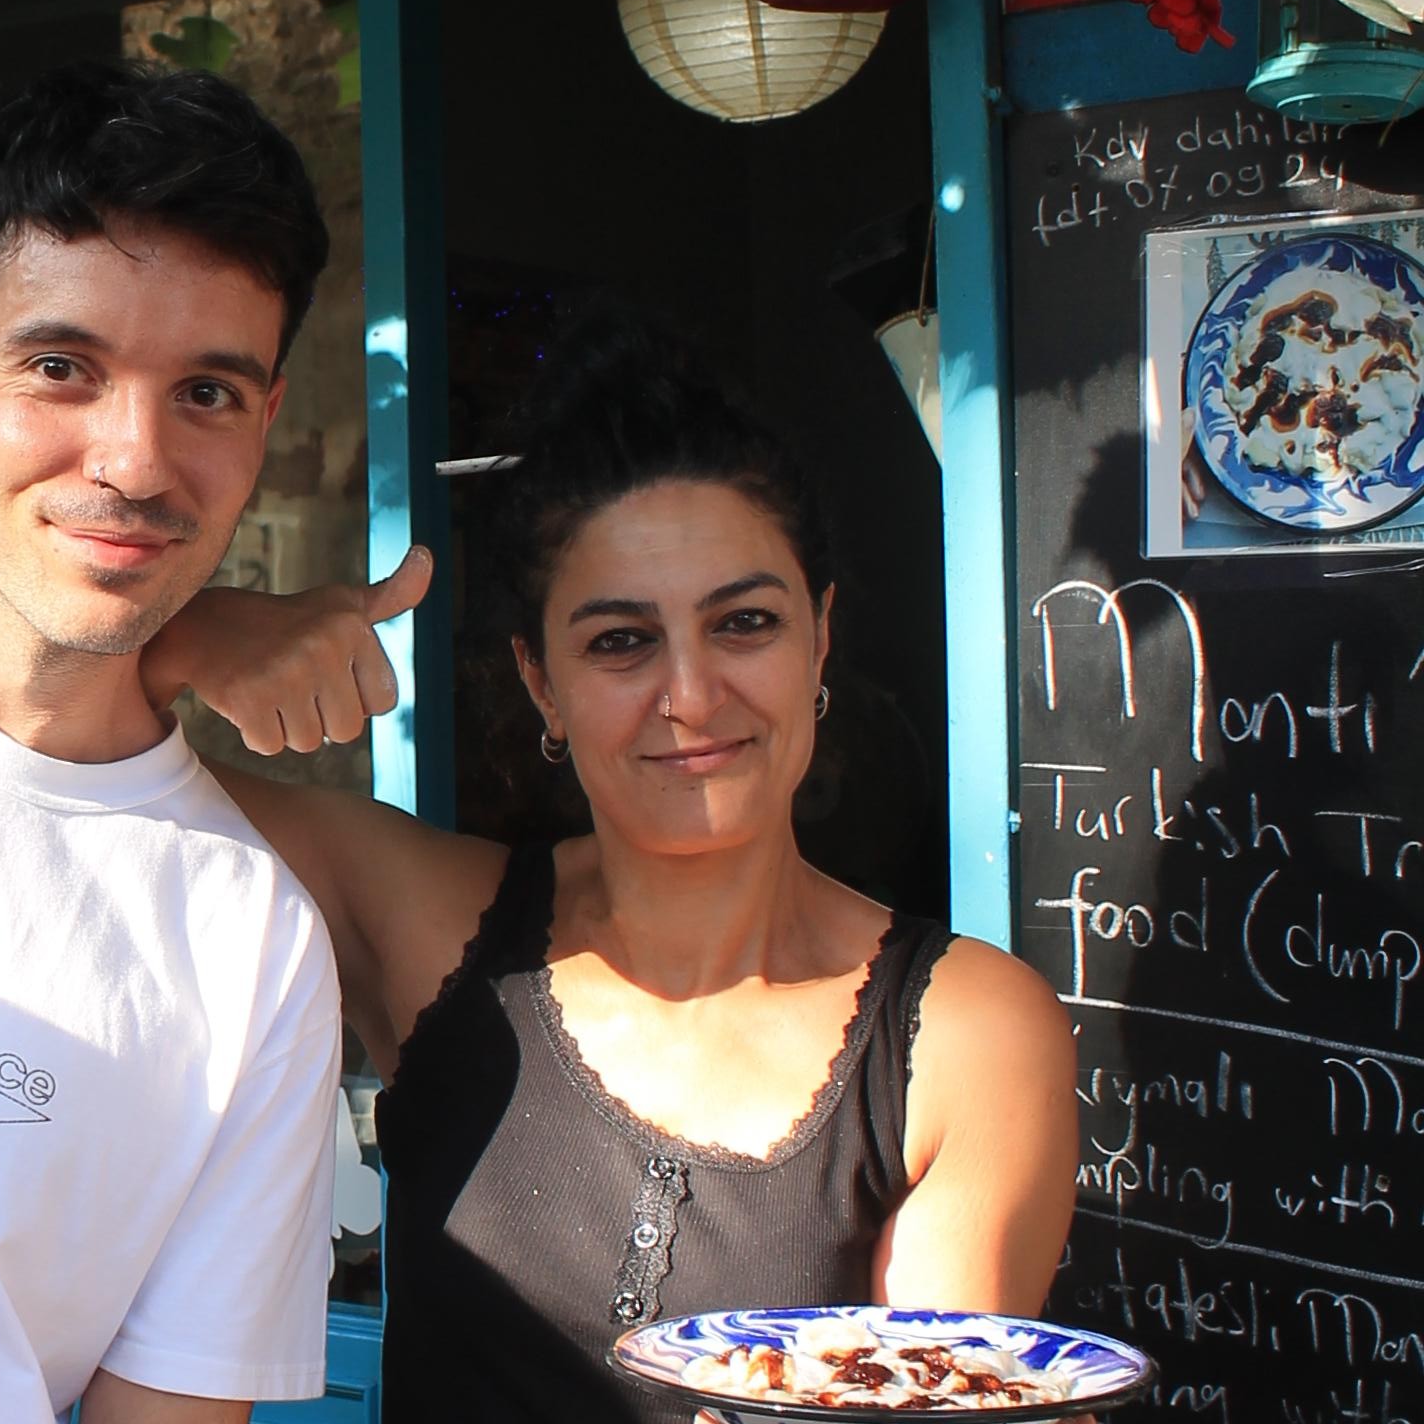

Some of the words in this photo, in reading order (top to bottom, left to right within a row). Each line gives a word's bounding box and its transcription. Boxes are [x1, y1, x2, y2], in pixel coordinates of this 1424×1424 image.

[1020, 762, 1292, 859] Turkish
[1034, 867, 1210, 1000] food
[1076, 1143, 1233, 1250] mpling
[1275, 1163, 1395, 1230] with
